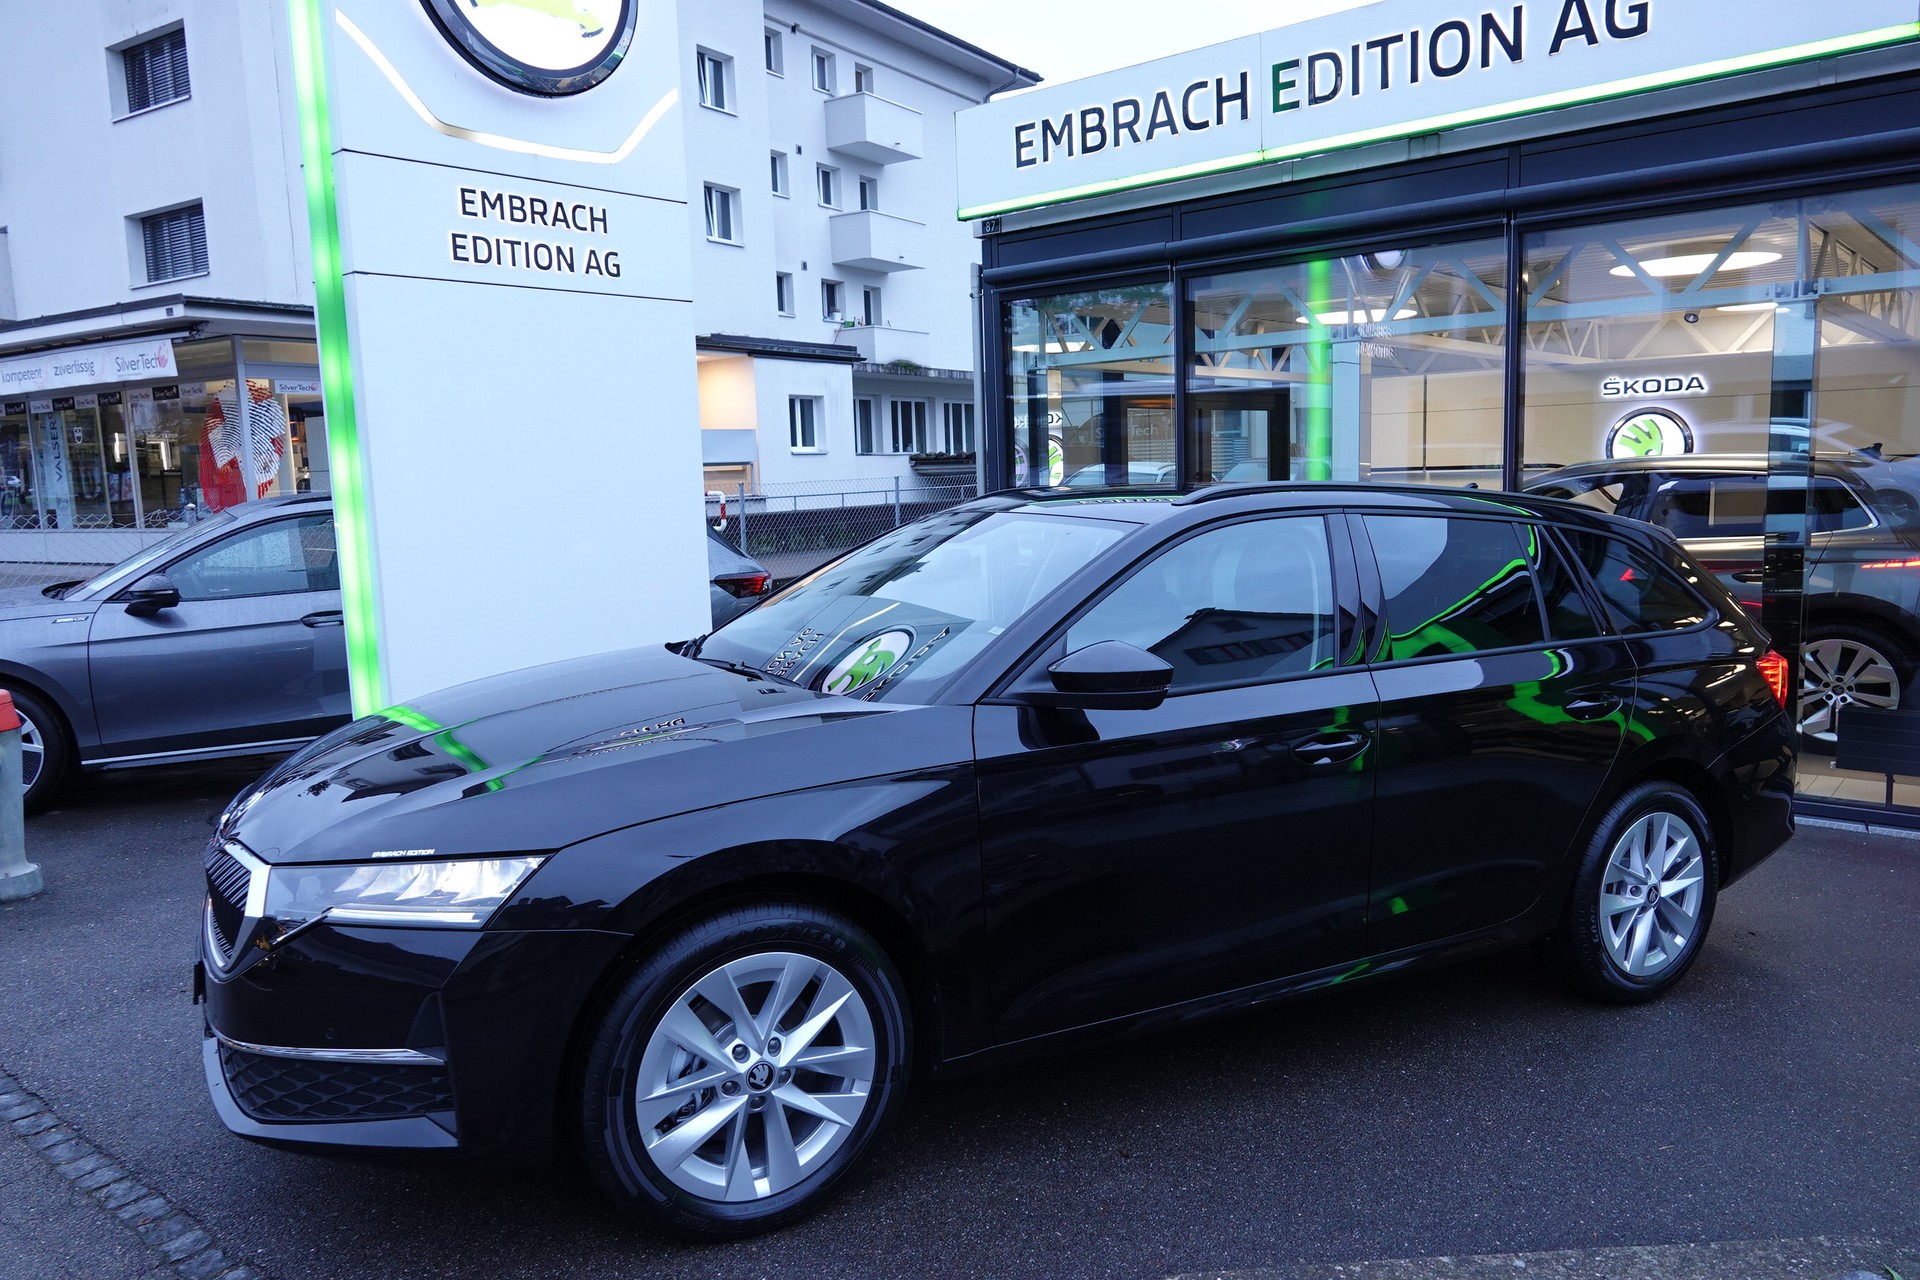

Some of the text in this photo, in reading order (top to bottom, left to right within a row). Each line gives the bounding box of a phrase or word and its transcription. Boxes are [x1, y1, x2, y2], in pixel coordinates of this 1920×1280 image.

[1015, 0, 1649, 168] EMBRACH EDITION AG
[460, 187, 608, 234] EMBRACH
[985, 220, 996, 232] 87
[451, 233, 621, 278] EDITION AG
[1, 352, 162, 385] kompetent zuverlässig SilverTech
[279, 383, 312, 391] SilverTech
[1603, 376, 1705, 396] ŠKODA
[49, 418, 63, 482] VALSER
[406, 848, 435, 856] EDITION
